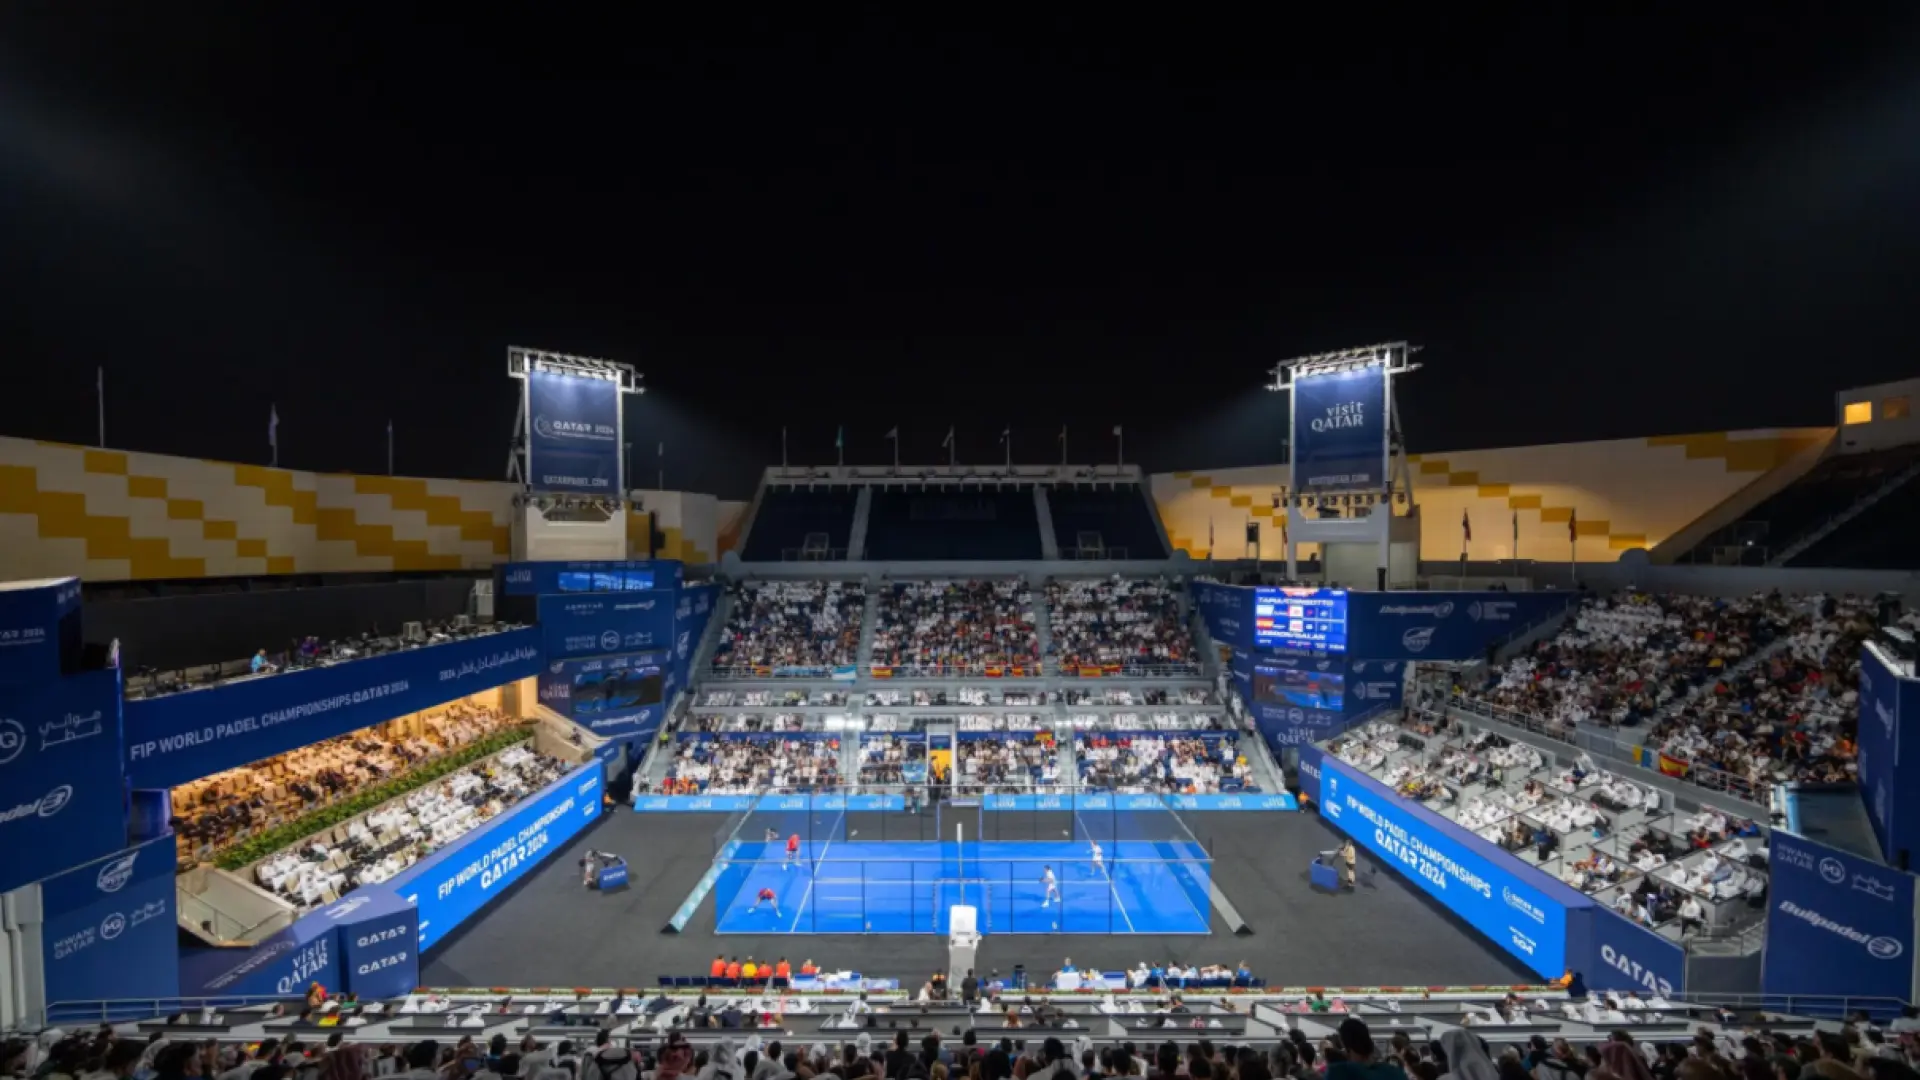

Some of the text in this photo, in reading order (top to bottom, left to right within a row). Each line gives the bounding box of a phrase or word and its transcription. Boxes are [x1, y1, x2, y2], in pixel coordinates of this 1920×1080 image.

[553, 420, 592, 432] QATAR
[1311, 413, 1364, 432] QATAR
[1326, 401, 1364, 417] visit
[130, 741, 156, 761] FIP
[158, 726, 214, 752] WORLD
[216, 716, 260, 738] PADEL
[261, 691, 352, 727] CHAMPIONSHIPS
[352, 683, 391, 704] QATAR
[438, 878, 455, 900] FIP
[456, 855, 490, 889] WORLD
[491, 837, 518, 862] PADEL
[518, 796, 575, 844] CHAMPIONSHIPS
[480, 830, 549, 889] QATAR 2024
[1358, 802, 1384, 827] WORLD
[1384, 818, 1409, 845] PADEL
[1410, 835, 1491, 899] CHAMPIONSHIPS
[1375, 829, 1447, 890] QATAR 2024
[357, 925, 407, 948] QATAR
[1779, 900, 1871, 944] Bullpadel
[277, 951, 329, 994] QATAR
[292, 937, 328, 969] visit
[358, 952, 407, 975] QATAR
[1601, 945, 1673, 999] QATAR
